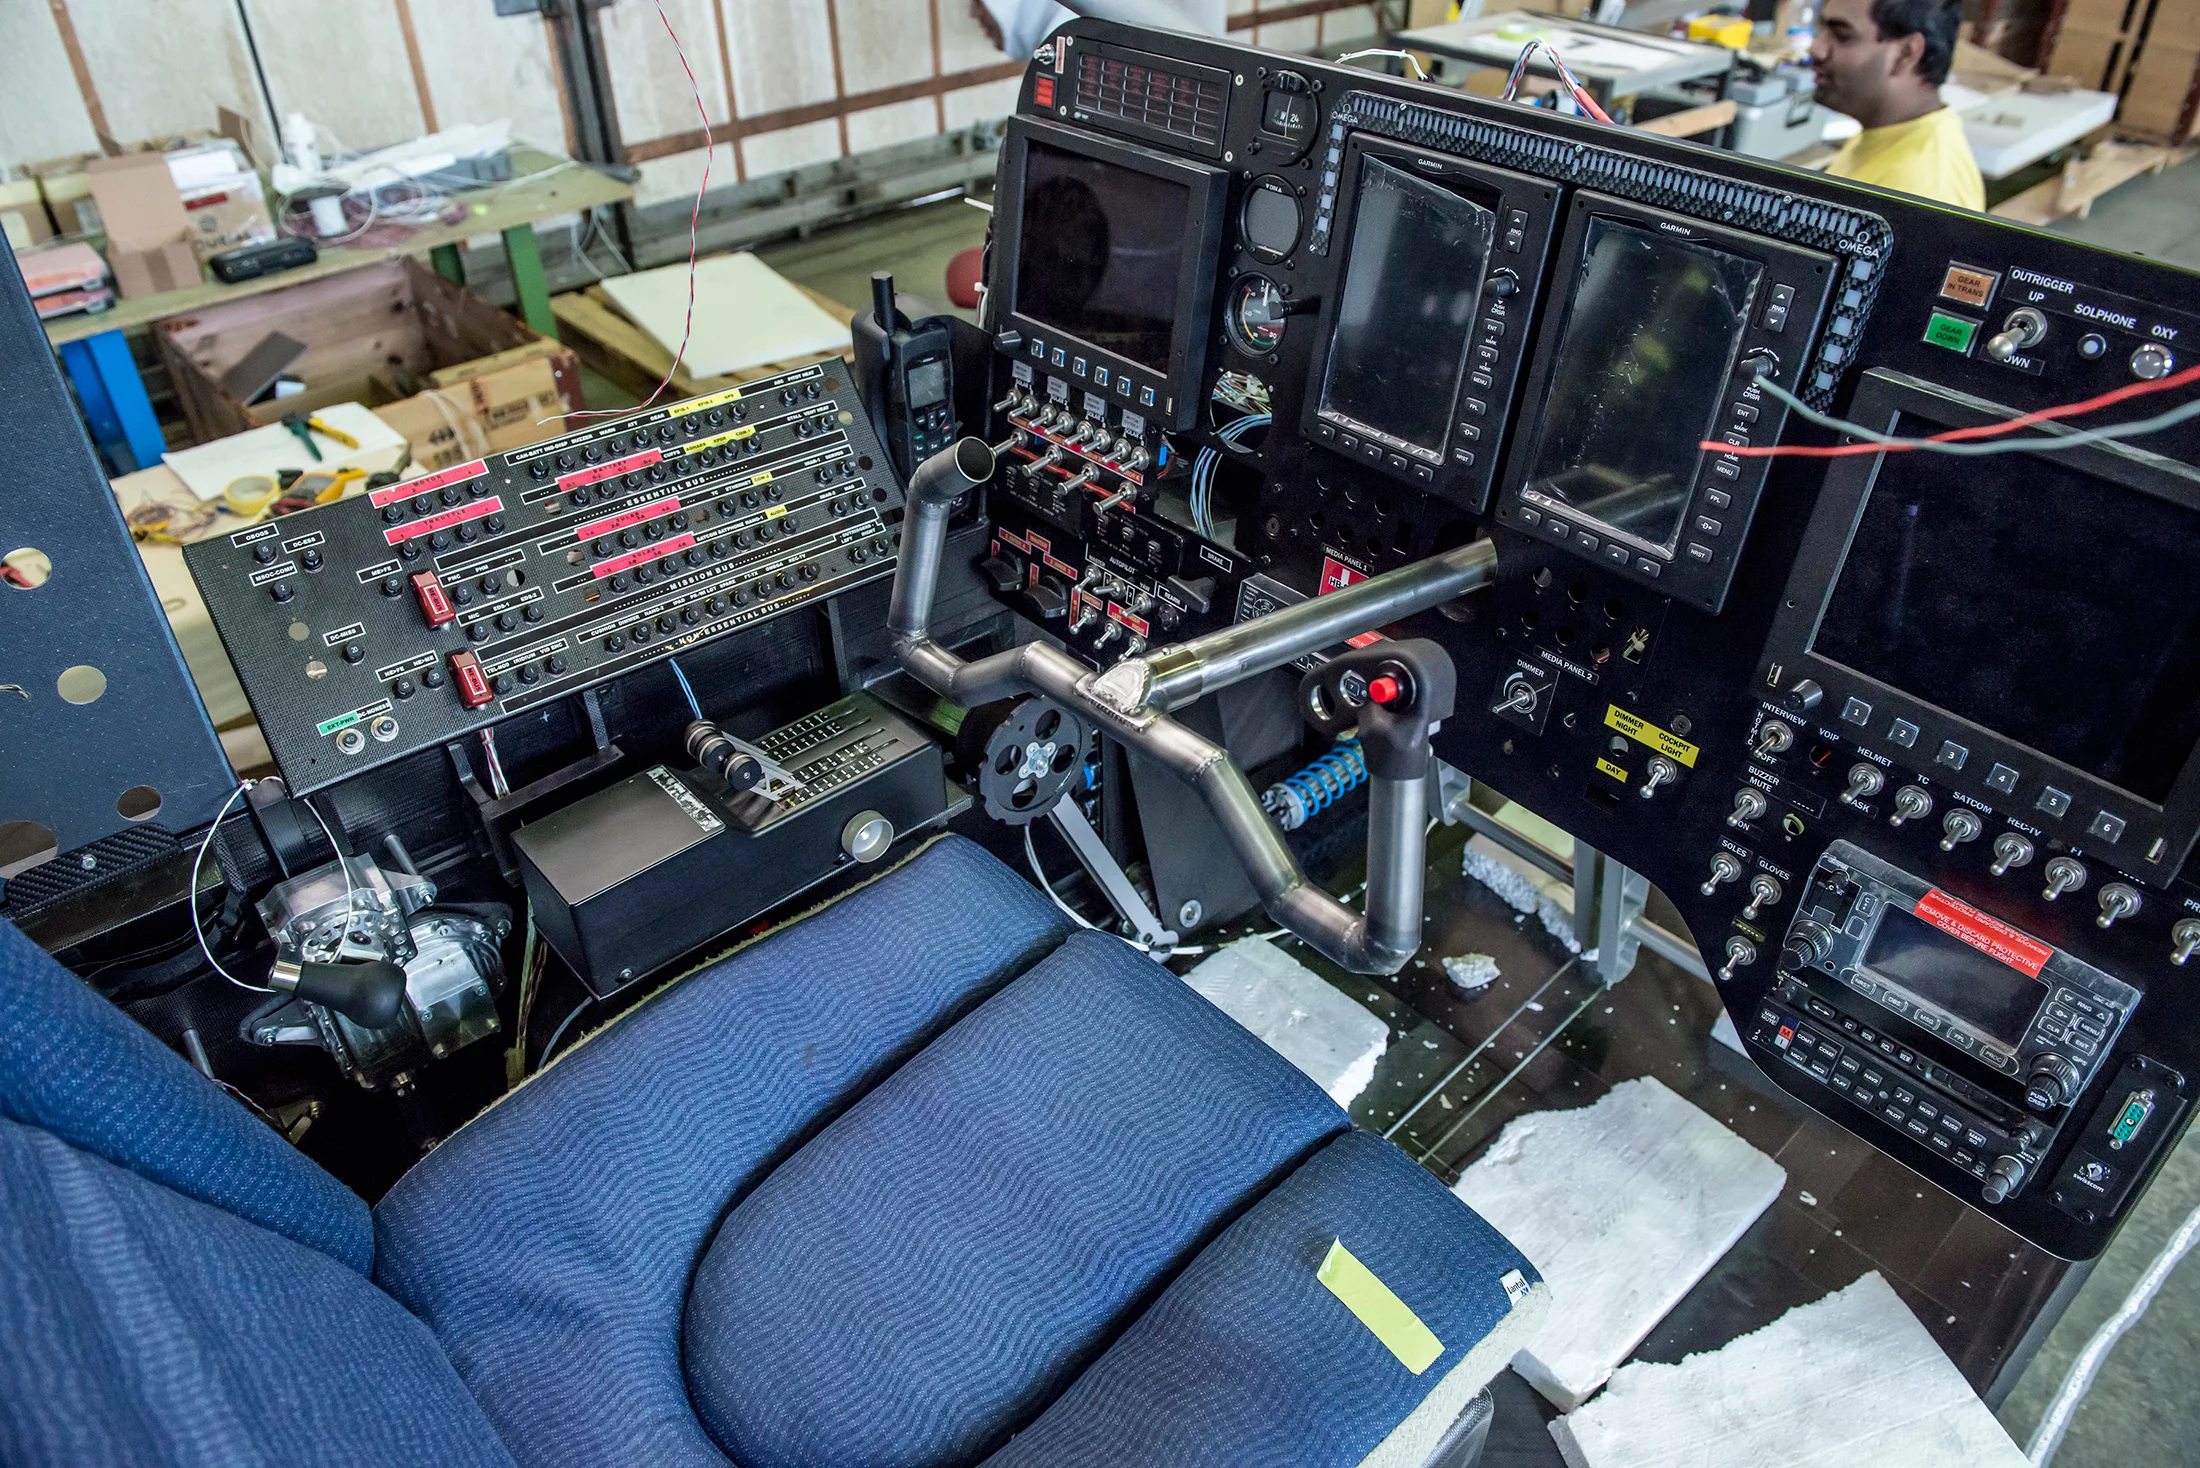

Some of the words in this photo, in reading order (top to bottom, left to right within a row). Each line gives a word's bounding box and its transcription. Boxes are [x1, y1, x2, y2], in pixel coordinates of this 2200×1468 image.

[1290, 114, 1299, 122] 24
[1332, 111, 1358, 124] OMEGA
[1418, 158, 1442, 170] GARMIN
[1510, 228, 1522, 236] RNG
[1660, 222, 1690, 236] GARMIN
[1838, 239, 1880, 258] OMEGA
[1958, 276, 1981, 286] GEAR
[2012, 269, 2074, 294] OUTRIGGER
[1947, 283, 1956, 291] IN
[1957, 284, 1983, 298] TRANS
[2028, 290, 2044, 302] UP
[1772, 304, 1785, 313] RNG
[2074, 303, 2136, 328] SOLPHONE
[1487, 324, 1498, 332] ENT
[1940, 323, 1963, 336] GEAR
[2152, 325, 2178, 340] OXY
[1936, 332, 1960, 344] DOWN
[2003, 355, 2030, 368] OWN
[1474, 377, 1488, 386] MENU
[1743, 390, 1760, 400] CRSR
[1746, 386, 1760, 394] PUSH
[1737, 409, 1749, 417] ENT
[1734, 424, 1748, 433] MARK
[516, 448, 542, 460] CAN-BATT
[572, 434, 593, 444] BUZZER
[599, 427, 616, 436] WARN
[650, 413, 665, 421] GEAR
[1728, 438, 1740, 446] CLR
[663, 449, 681, 458] CUFFS
[1724, 453, 1739, 462] HOME
[593, 460, 626, 473] BATTERY
[725, 480, 751, 492] ETHERNET
[825, 451, 844, 460] SERVOS
[1717, 465, 1734, 476] MENU
[413, 475, 441, 486] MOTOR
[627, 485, 683, 506] ESSENTIAL
[686, 476, 705, 488] BUS
[1710, 495, 1720, 503] FPL
[424, 509, 466, 526] THROTTLE
[697, 530, 717, 542] SATCOM
[718, 522, 744, 535] SATPHONE
[770, 508, 785, 516] AUDIO
[246, 530, 269, 541] OBOGS
[861, 528, 876, 536] RIGHT
[292, 537, 316, 548] DC-ESS
[1207, 553, 1224, 566] BRAKE
[1326, 547, 1344, 561] MEDIA
[1344, 555, 1362, 569] PANEL
[1690, 549, 1705, 559] NRST
[1110, 556, 1135, 575] AUTOPILOT
[255, 566, 294, 582] MSOC-COMP
[447, 574, 461, 582] PMC
[670, 570, 712, 590] MISSION
[716, 562, 734, 573] BUS
[591, 624, 616, 636] CUSHION
[618, 614, 640, 626] DIMMER
[644, 605, 665, 616] NANO-2
[672, 597, 686, 605] IPAD
[720, 580, 736, 589] SPARE
[766, 562, 783, 571] OMEGA
[788, 554, 806, 563] REC-TV
[468, 612, 480, 620] MIC
[492, 602, 510, 612] EDS-1
[521, 592, 538, 602] EDS-2
[679, 612, 759, 645] NON-ESSENTIAL
[761, 602, 780, 614] BUS
[330, 628, 357, 641] DC-MISS
[487, 662, 510, 674] TEL-MOD
[513, 652, 536, 664] IRIDIUM
[540, 645, 550, 654] VID
[551, 642, 563, 650] ENC
[1517, 659, 1545, 678] DIMMER
[1541, 650, 1563, 667] MEDIA
[1564, 662, 1586, 678] PANEL
[1586, 672, 1593, 681] 2
[1614, 709, 1644, 730] DIMMER
[1762, 702, 1807, 727] INTERVIEW
[327, 716, 355, 730] EXT-PWR
[1615, 721, 1638, 736] NIGHT
[1819, 728, 1840, 742] VOIP
[1659, 732, 1691, 752] COCKPIT
[1660, 743, 1683, 759] LIGHT
[1858, 746, 1894, 767] HELMET
[1760, 753, 1777, 765] OFF
[1605, 763, 1620, 775] DAY
[1748, 765, 1780, 786] BUZZER
[1917, 774, 1930, 785] TC
[1750, 776, 1772, 793] MUTE
[1851, 800, 1870, 813] ASK
[1952, 791, 1992, 815] SATCOM
[2050, 798, 2057, 806] 5
[1738, 821, 1750, 831] ON
[2007, 816, 2041, 837] REC-TV
[2104, 824, 2111, 832] 6
[1721, 839, 1747, 858] SOLES
[1759, 860, 1791, 881] GLOVES
[1929, 893, 1974, 918] PROTECTIVE
[1975, 917, 2007, 935] DISCARD
[1919, 904, 1953, 923] REMOVE
[1958, 924, 1990, 945] DISCARD
[1991, 940, 2039, 970] PROTECTIVE
[1937, 921, 1961, 936] COVER
[1961, 933, 1988, 952] BEFORE
[1988, 948, 2014, 964] FLIGHT
[2015, 938, 2048, 956] REMOVE
[1855, 978, 1871, 989] NRST
[2077, 1002, 2092, 1012] RNG
[1920, 1014, 1934, 1024] MSG
[2046, 1024, 2060, 1034] CLR
[2081, 1024, 2100, 1036] MENU
[1797, 1033, 1812, 1045] COM1
[1954, 1033, 1965, 1043] FPL
[2075, 1039, 2089, 1049] ENT
[1790, 1052, 1802, 1061] MIC1
[1819, 1045, 1835, 1058] COM2
[1985, 1052, 2002, 1063] PROC
[1842, 1060, 1855, 1070] NAV1
[2072, 1055, 2088, 1066] GPS
[1812, 1063, 1824, 1074] MIC2
[1834, 1077, 1847, 1087] PLAY
[1864, 1073, 1878, 1084] NAV2
[1856, 1092, 1868, 1101] AUX
[2028, 1097, 2046, 1108] CRSR
[2030, 1091, 2048, 1103] PUSH
[1886, 1108, 1902, 1120] PILOT
[1919, 1105, 1934, 1117] MUS1
[1908, 1122, 1925, 1134] COPLT
[1942, 1119, 1959, 1131] MUS2
[1933, 1136, 1948, 1148] PASS
[1969, 1133, 1982, 1142] MAN
[1957, 1151, 1973, 1162] SPKR
[2073, 1173, 2104, 1193] swisscom
[1507, 1278, 1525, 1294] Lantal
